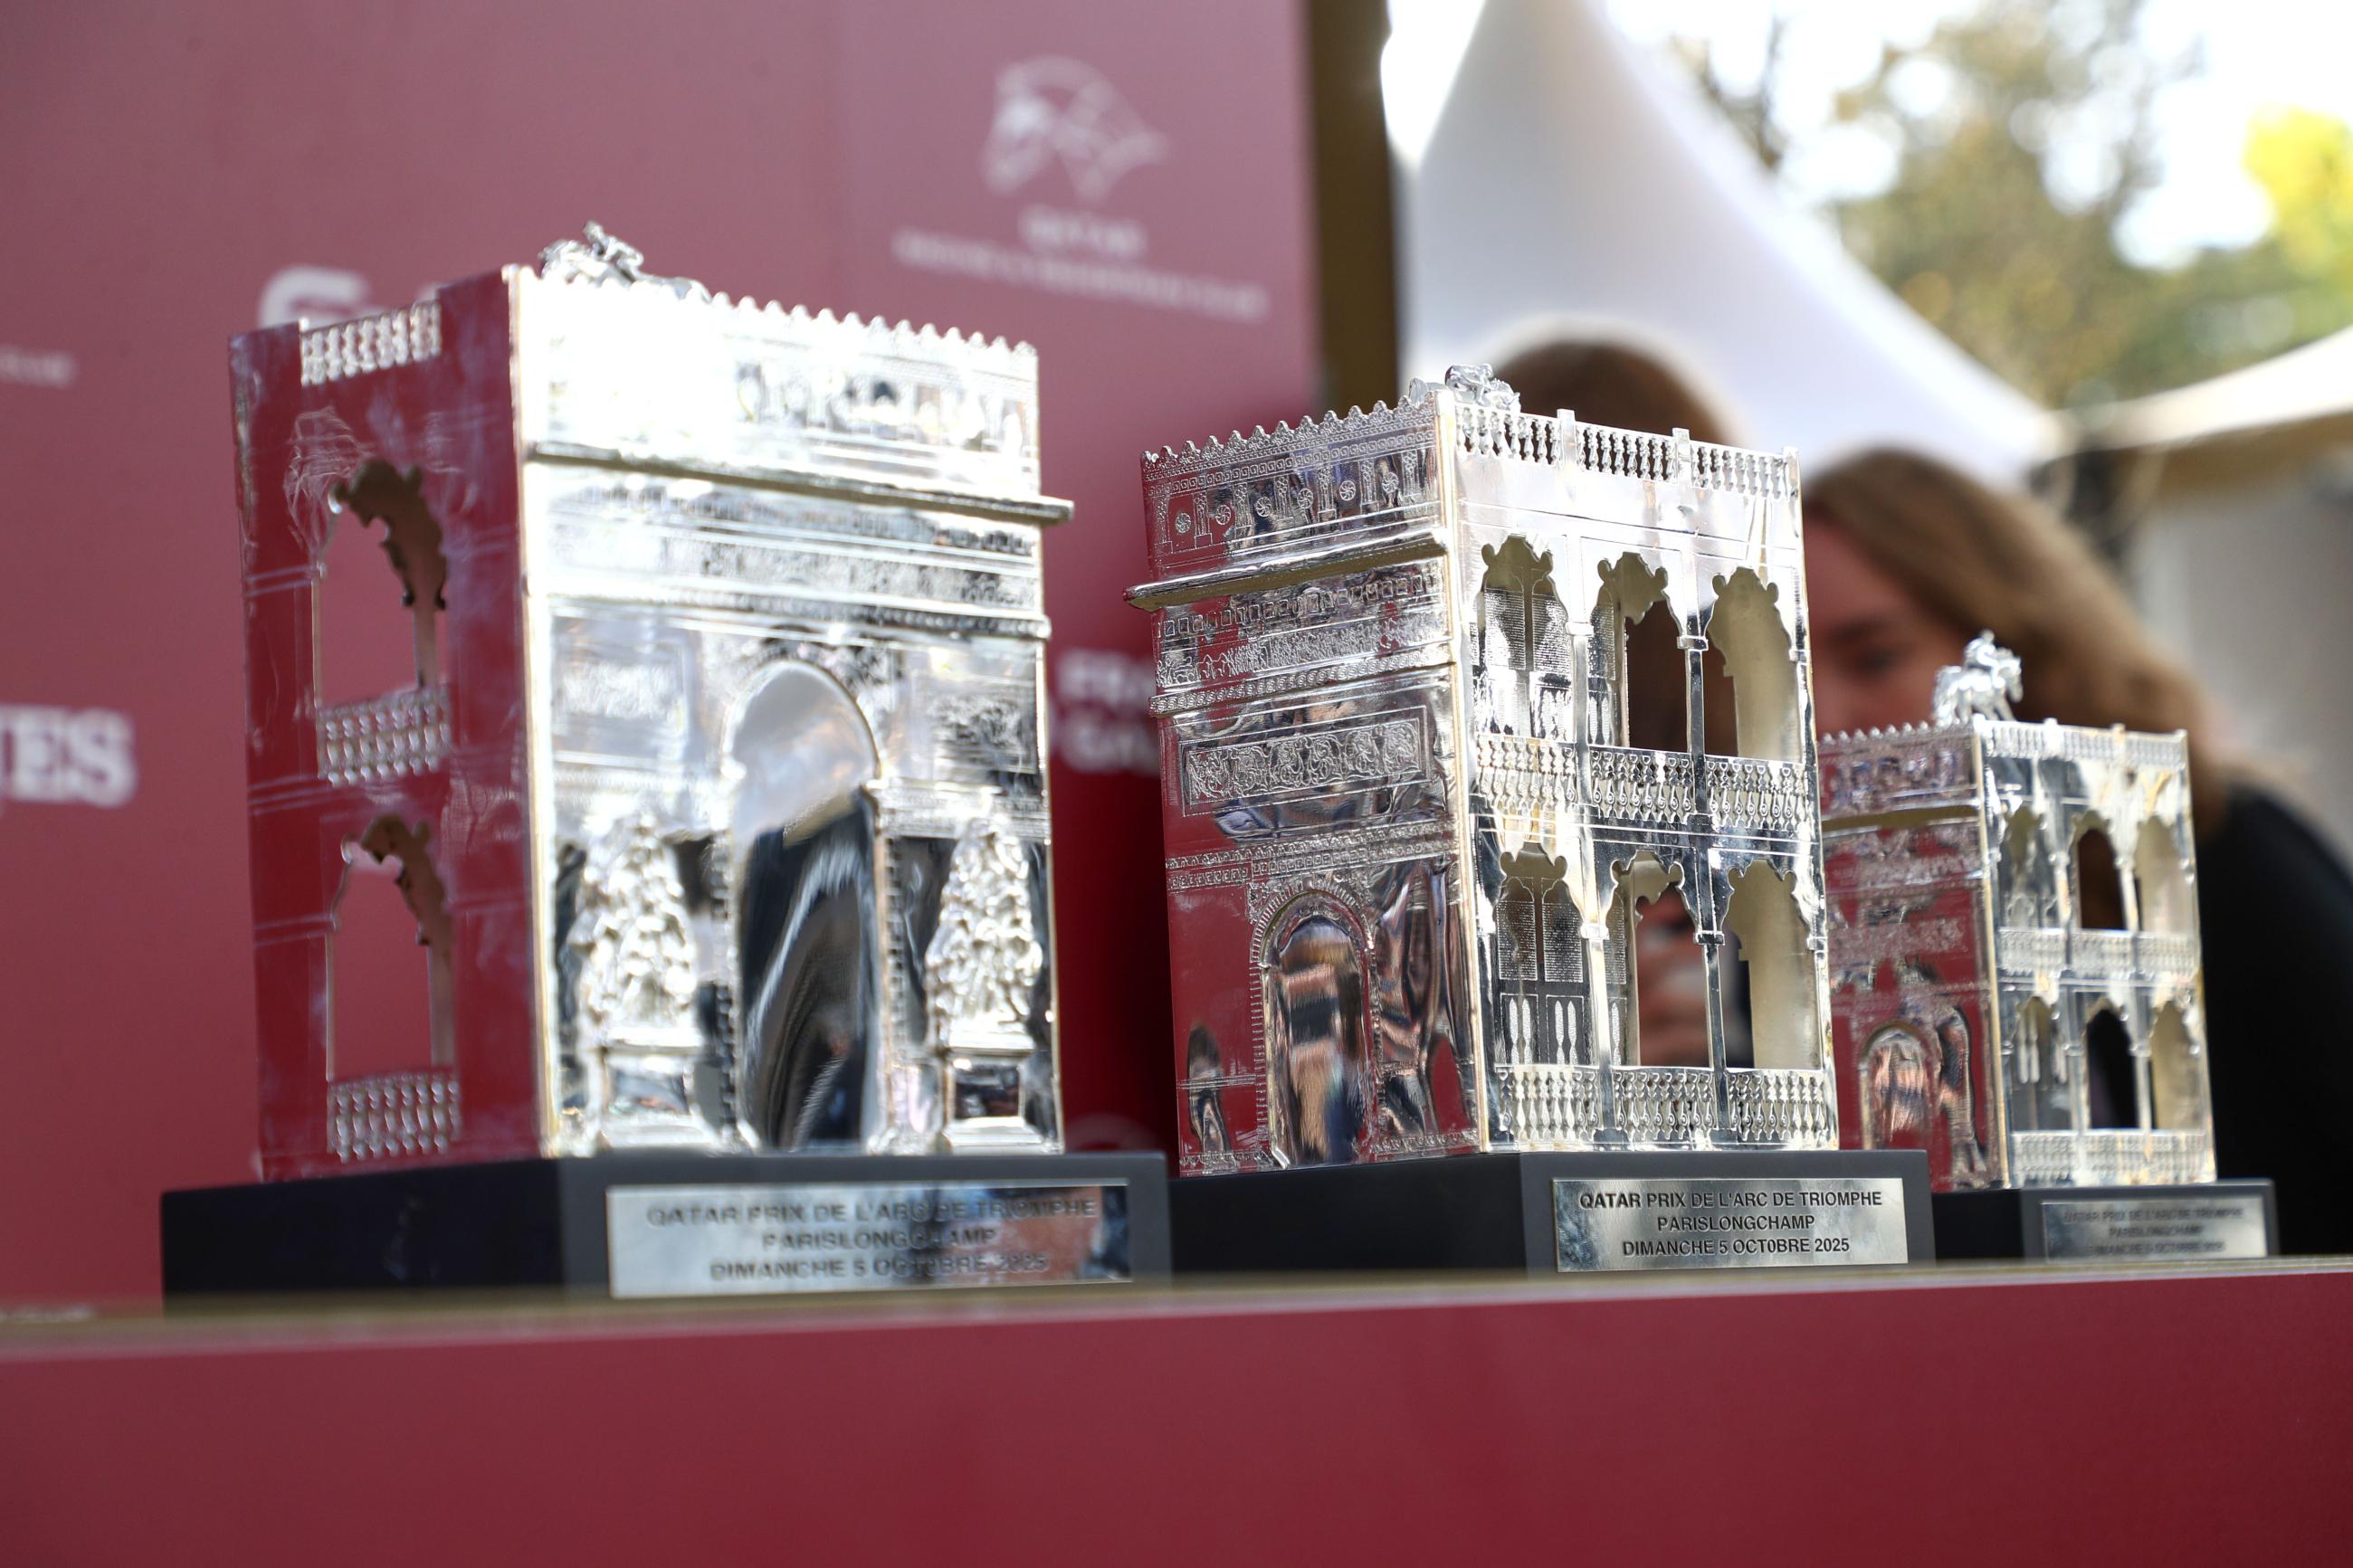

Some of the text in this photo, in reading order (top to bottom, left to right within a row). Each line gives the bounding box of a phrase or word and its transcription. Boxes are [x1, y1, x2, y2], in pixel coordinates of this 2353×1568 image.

[1579, 1191, 1882, 1209] QATAR PRIX DE L'ARC DE TRIOMPHE
[647, 1201, 738, 1228] QATAR
[814, 1202, 846, 1223] DE
[976, 1198, 1097, 1219] TRIOMPHE
[1657, 1215, 1815, 1231] PARISLONGCHAMP
[1623, 1240, 1714, 1256] DIMANCHE
[1719, 1240, 1728, 1255] 5
[1815, 1238, 1850, 1252] 2025
[710, 1258, 846, 1282] DIMANCHE
[853, 1258, 869, 1278] 5
